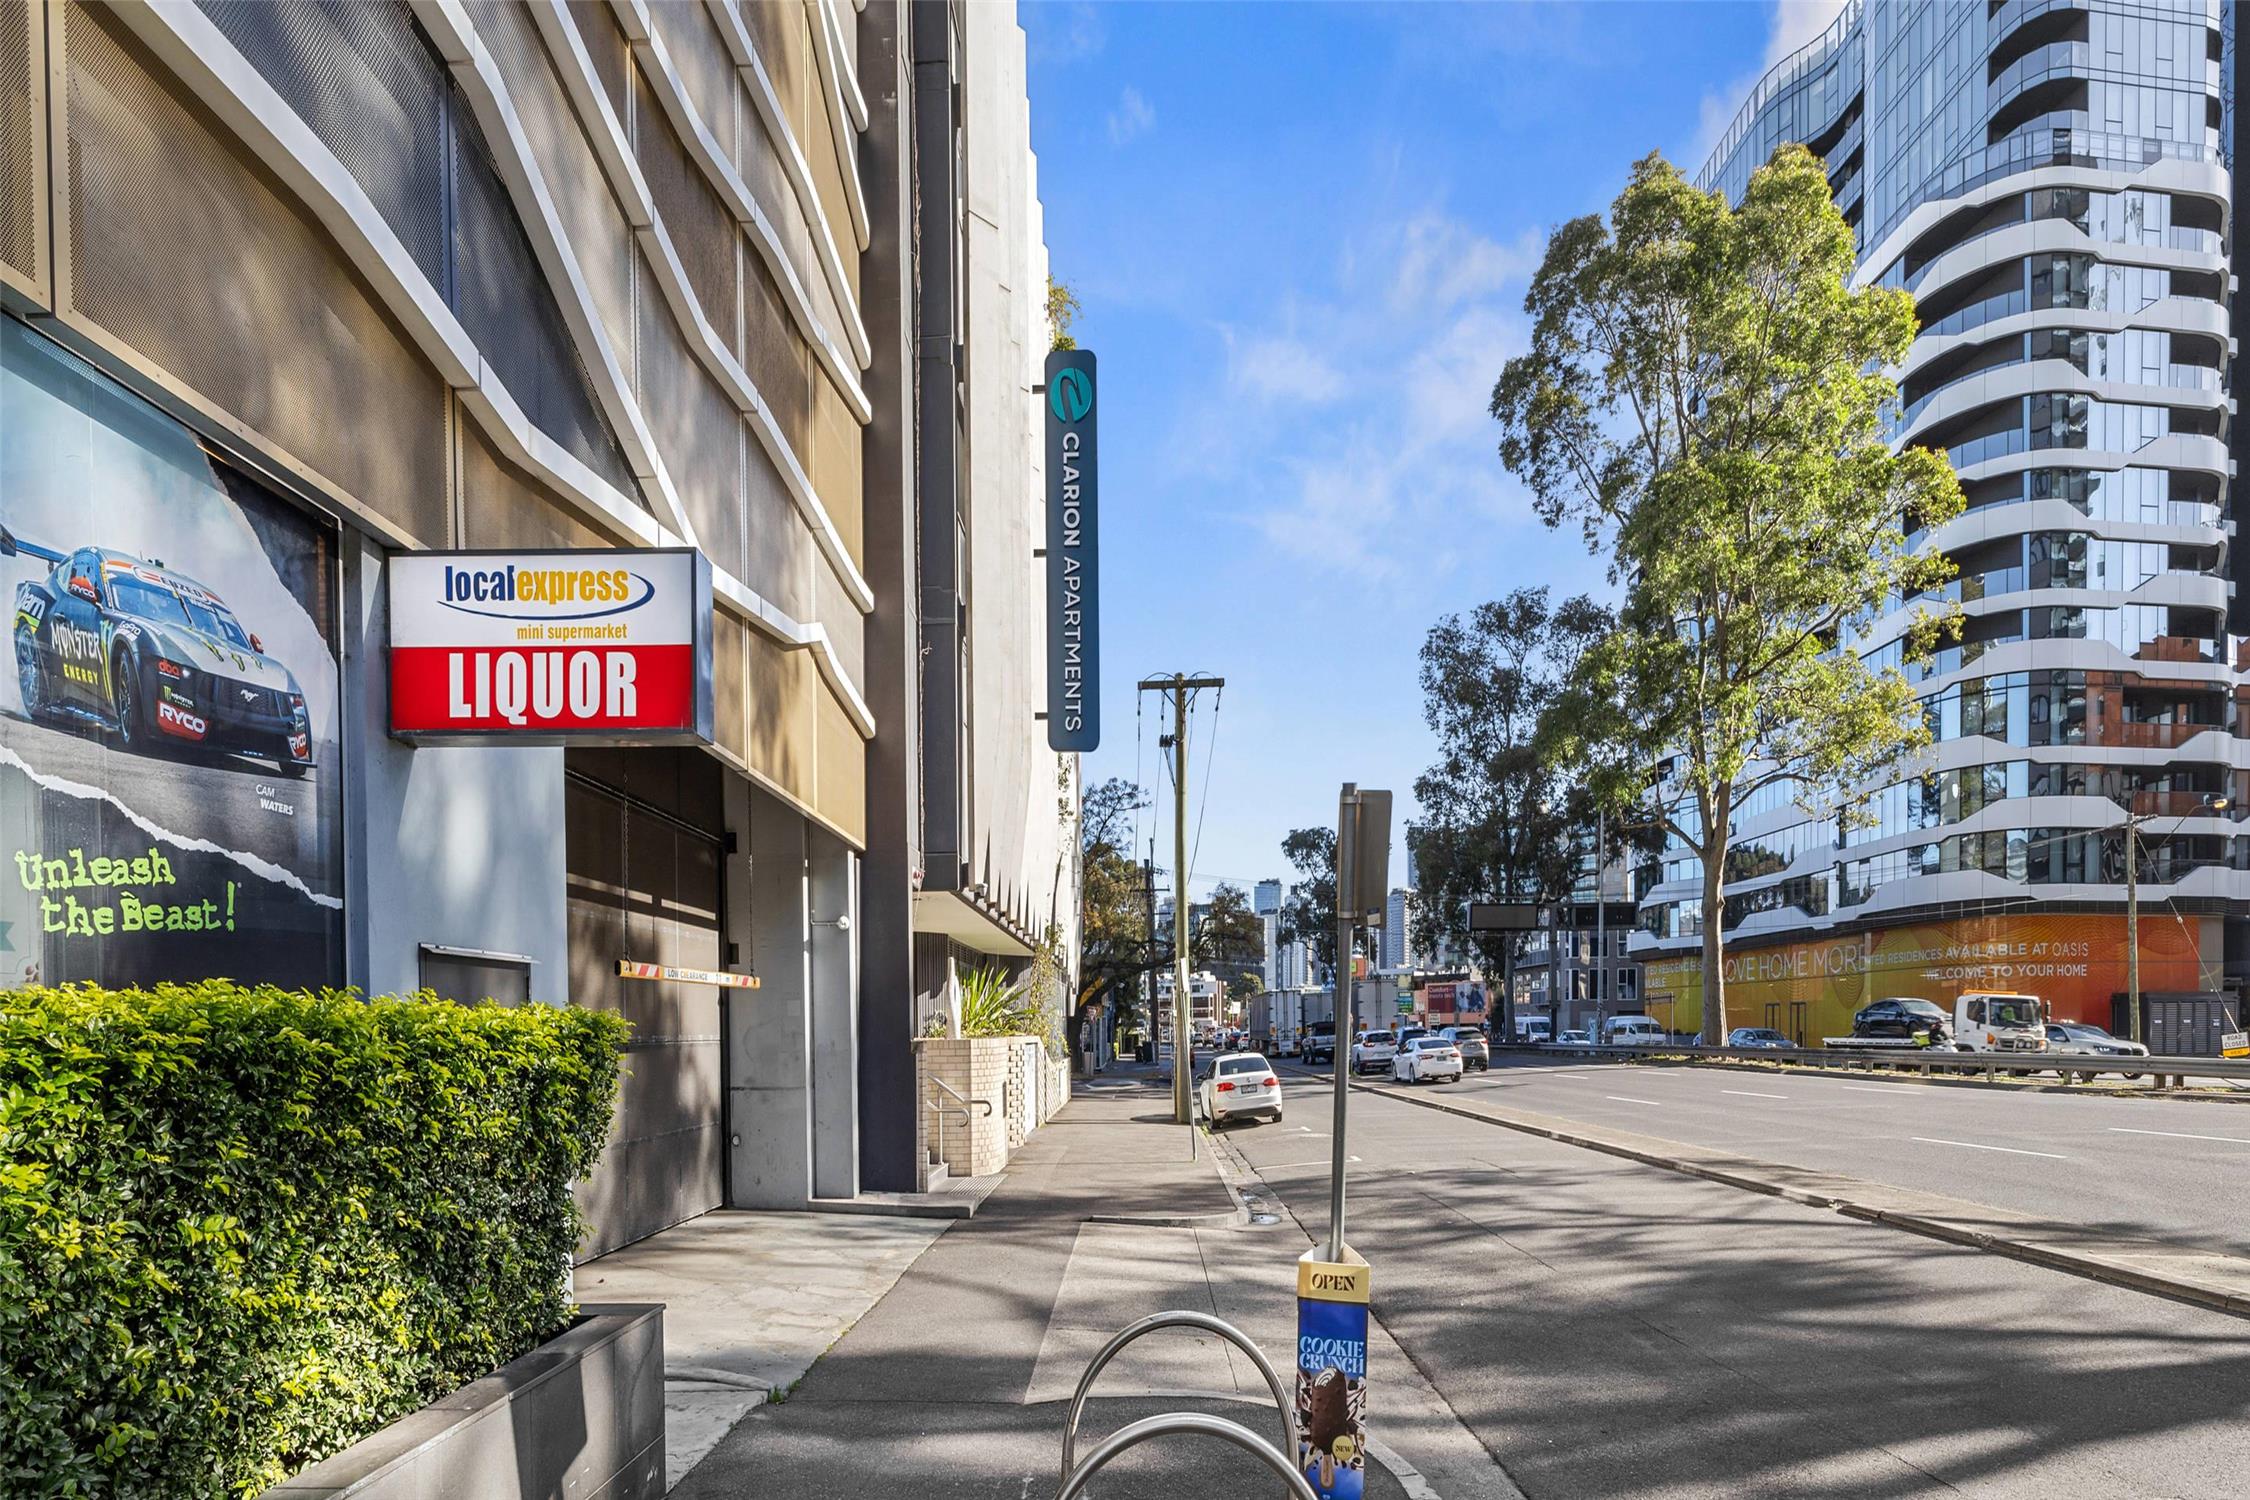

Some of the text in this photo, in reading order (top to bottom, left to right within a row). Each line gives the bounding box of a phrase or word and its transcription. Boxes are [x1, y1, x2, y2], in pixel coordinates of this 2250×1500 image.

[445, 565, 630, 605] localexpress
[1062, 433, 1083, 732] CLARION APARTMENTS
[516, 623, 628, 642] mini supermarket
[63, 664, 98, 685] ENERGY
[449, 650, 637, 726] LIQUOR
[159, 703, 206, 734] RYCO
[255, 784, 275, 798] CAM
[260, 798, 294, 816] WATERS
[14, 847, 177, 892] Unleash
[40, 894, 115, 938] the
[1888, 948, 1943, 964] RESIDENCES
[1945, 943, 2028, 960] AVAILABLE
[2032, 942, 2049, 956] AT
[2052, 942, 2090, 957] OASIS
[1724, 957, 1756, 983] OVE
[1760, 950, 1808, 979] HOME
[1926, 963, 2088, 981] WELCOME TO YOUR HOME
[1312, 1273, 1356, 1292] OPEN
[1299, 1336, 1365, 1359] COOKIE
[1299, 1352, 1365, 1375] CRUNCH
[1335, 1444, 1353, 1455] NEW
